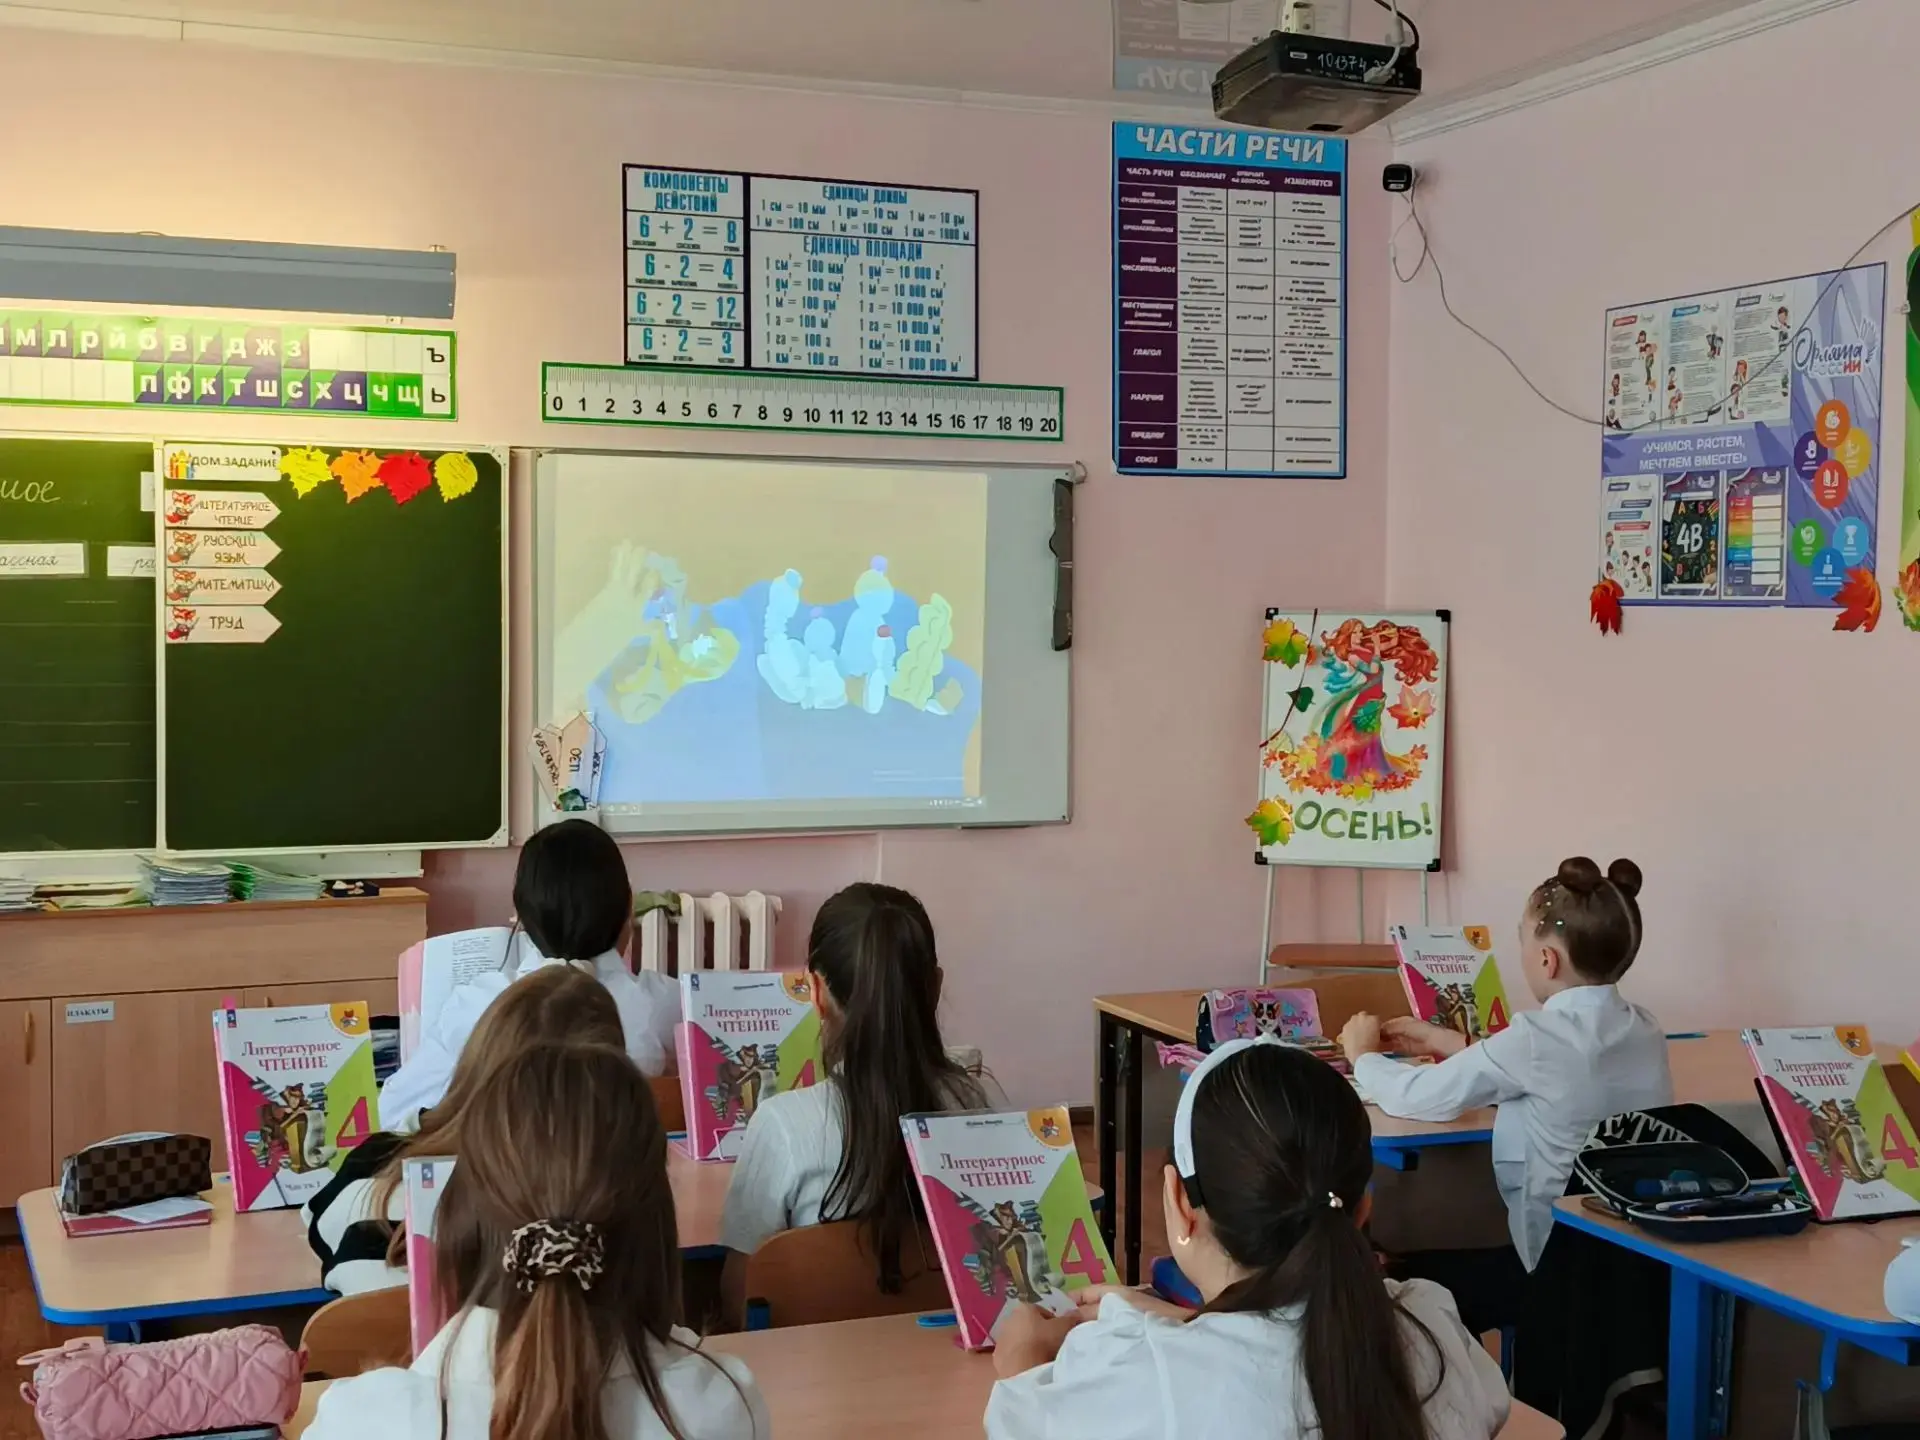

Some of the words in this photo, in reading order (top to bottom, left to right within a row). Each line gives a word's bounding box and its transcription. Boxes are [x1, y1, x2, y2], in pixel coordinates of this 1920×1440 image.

[1136, 127, 1237, 157] ЧАСТИ
[1245, 135, 1325, 164] РЕЧИ
[640, 215, 649, 237] 6
[684, 217, 694, 241] 2
[727, 220, 736, 243] 8
[803, 235, 859, 256] ЕДИНИЦЫ
[866, 240, 922, 261] ПЛОЩАДИ
[645, 253, 655, 276] 6
[680, 255, 689, 278] 2
[723, 258, 733, 280] 4
[637, 291, 646, 314] 6
[672, 294, 682, 316] 2
[717, 296, 736, 319] 12
[16, 328, 36, 346] м
[48, 329, 67, 347] л
[80, 330, 99, 354] р
[139, 327, 157, 350] б
[643, 327, 652, 350] 6
[678, 329, 688, 352] 2
[722, 332, 731, 354] 3
[1796, 327, 1863, 370] Орлята
[140, 375, 157, 393] п
[167, 371, 191, 399] ф
[201, 377, 216, 395] к
[229, 378, 246, 396] т
[256, 379, 277, 397] ш
[344, 382, 362, 405] ц
[373, 384, 388, 402] ч
[398, 385, 420, 407] щ
[553, 396, 563, 411] 0
[578, 397, 586, 411] 1
[605, 398, 615, 413] 2
[632, 399, 642, 414] 3
[656, 401, 666, 415] 4
[681, 402, 691, 416] 5
[707, 403, 717, 418] 6
[732, 404, 742, 418] 7
[758, 405, 768, 420] 8
[783, 407, 793, 422] 9
[803, 408, 820, 423] 10
[830, 409, 843, 424] 11
[851, 410, 868, 425] 12
[876, 411, 893, 426] 13
[900, 412, 917, 427] 14
[926, 413, 942, 428] 15
[949, 414, 966, 429] 16
[973, 415, 988, 429] 17
[996, 416, 1012, 431] 18
[1018, 417, 1033, 432] 19
[1040, 417, 1057, 432] 20
[203, 533, 257, 547] РУССКИЙ
[214, 552, 248, 565] ЯЗЫК
[196, 578, 275, 591] МАТЕМАТИКА
[209, 616, 244, 630] ТРУД
[1294, 801, 1433, 842] ОСЕНЬ!
[1426, 963, 1471, 974] ЧТЕНИЕ
[703, 1004, 792, 1020] Литературное
[717, 1019, 780, 1033] ЧТЕНИЕ
[241, 1040, 342, 1057] Литературное
[259, 1055, 328, 1071] ЧТЕНИЕ
[1774, 1058, 1854, 1073] Литературное
[1792, 1073, 1850, 1087] ЧТЕНИЕ
[336, 1096, 370, 1148] 4
[1881, 1113, 1919, 1169] 4
[940, 1152, 1045, 1171] Литературное
[960, 1170, 1035, 1187] ЧТЕНИЕ
[1061, 1218, 1108, 1285] 4
